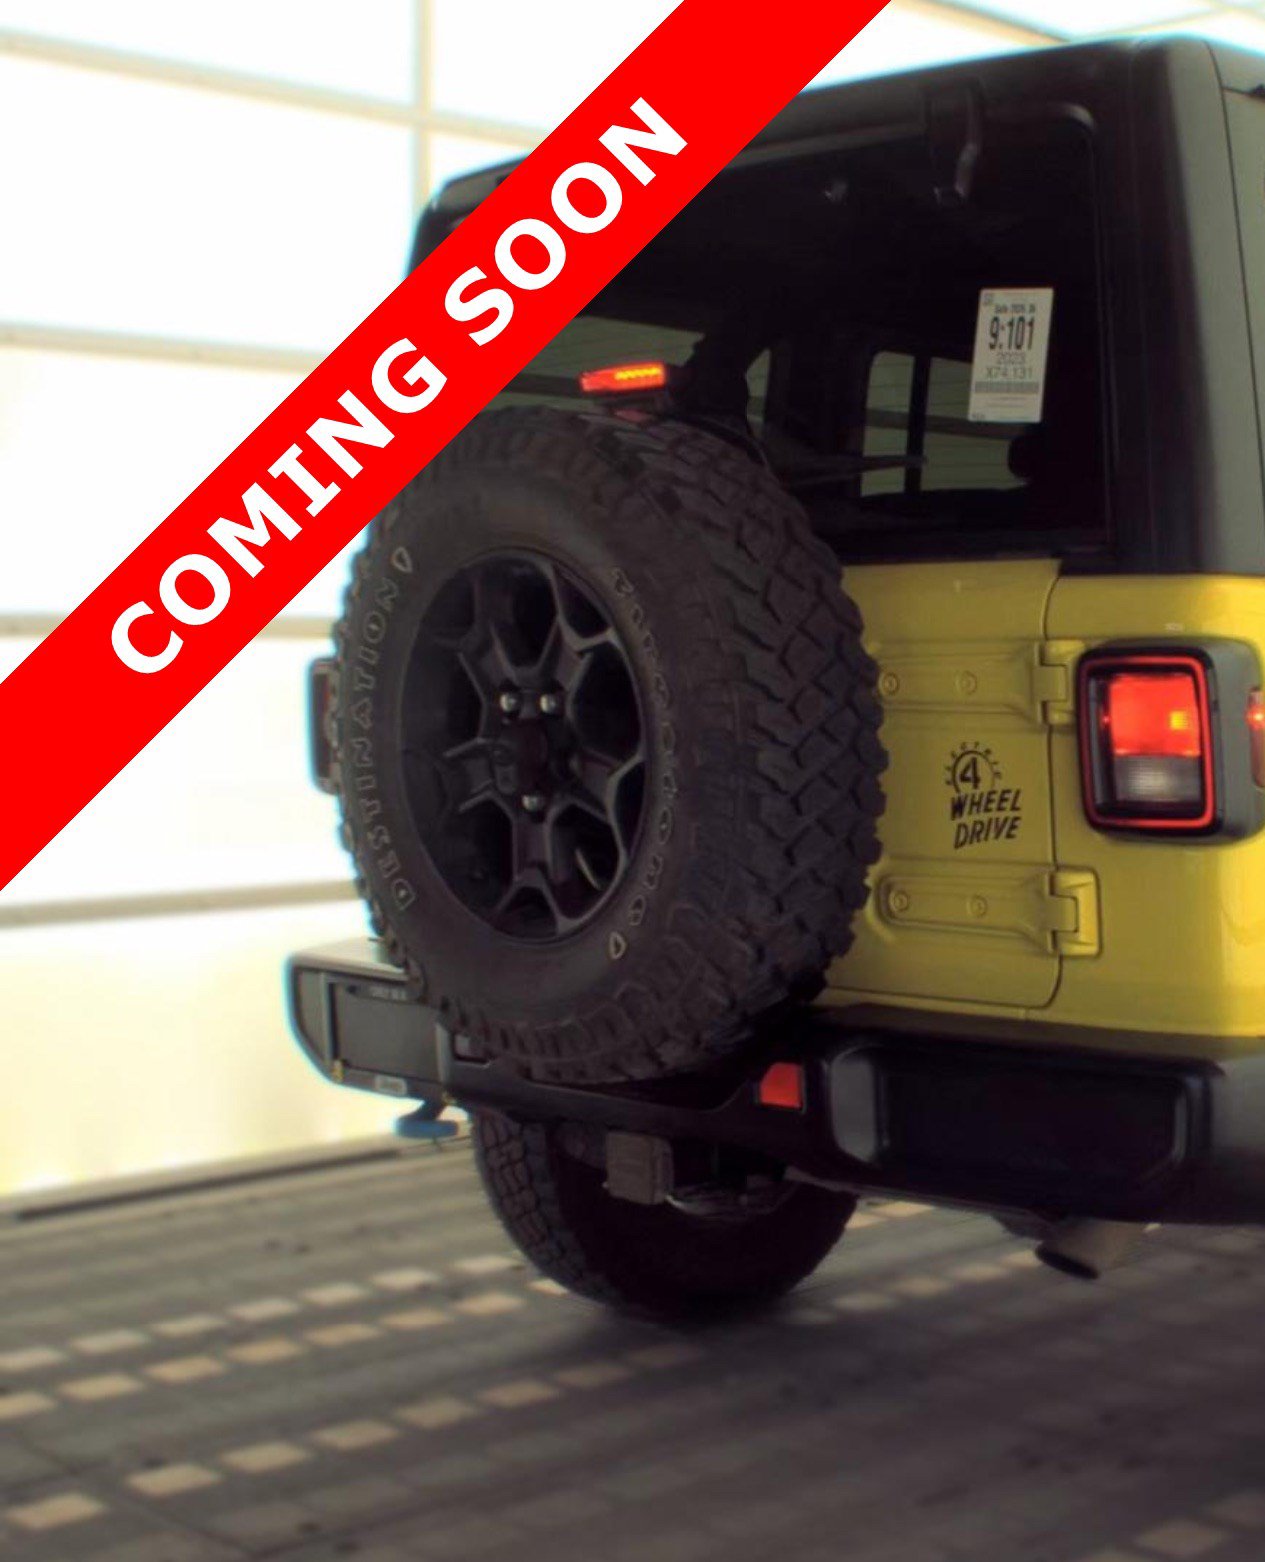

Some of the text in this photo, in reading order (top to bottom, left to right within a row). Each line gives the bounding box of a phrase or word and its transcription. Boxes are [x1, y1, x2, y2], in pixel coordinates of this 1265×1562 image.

[989, 316, 1035, 351] 9:101
[348, 575, 417, 912] DESTINATION
[959, 756, 981, 790] 4
[951, 788, 1021, 821] WHEEL
[954, 816, 1021, 850] DRIVE
